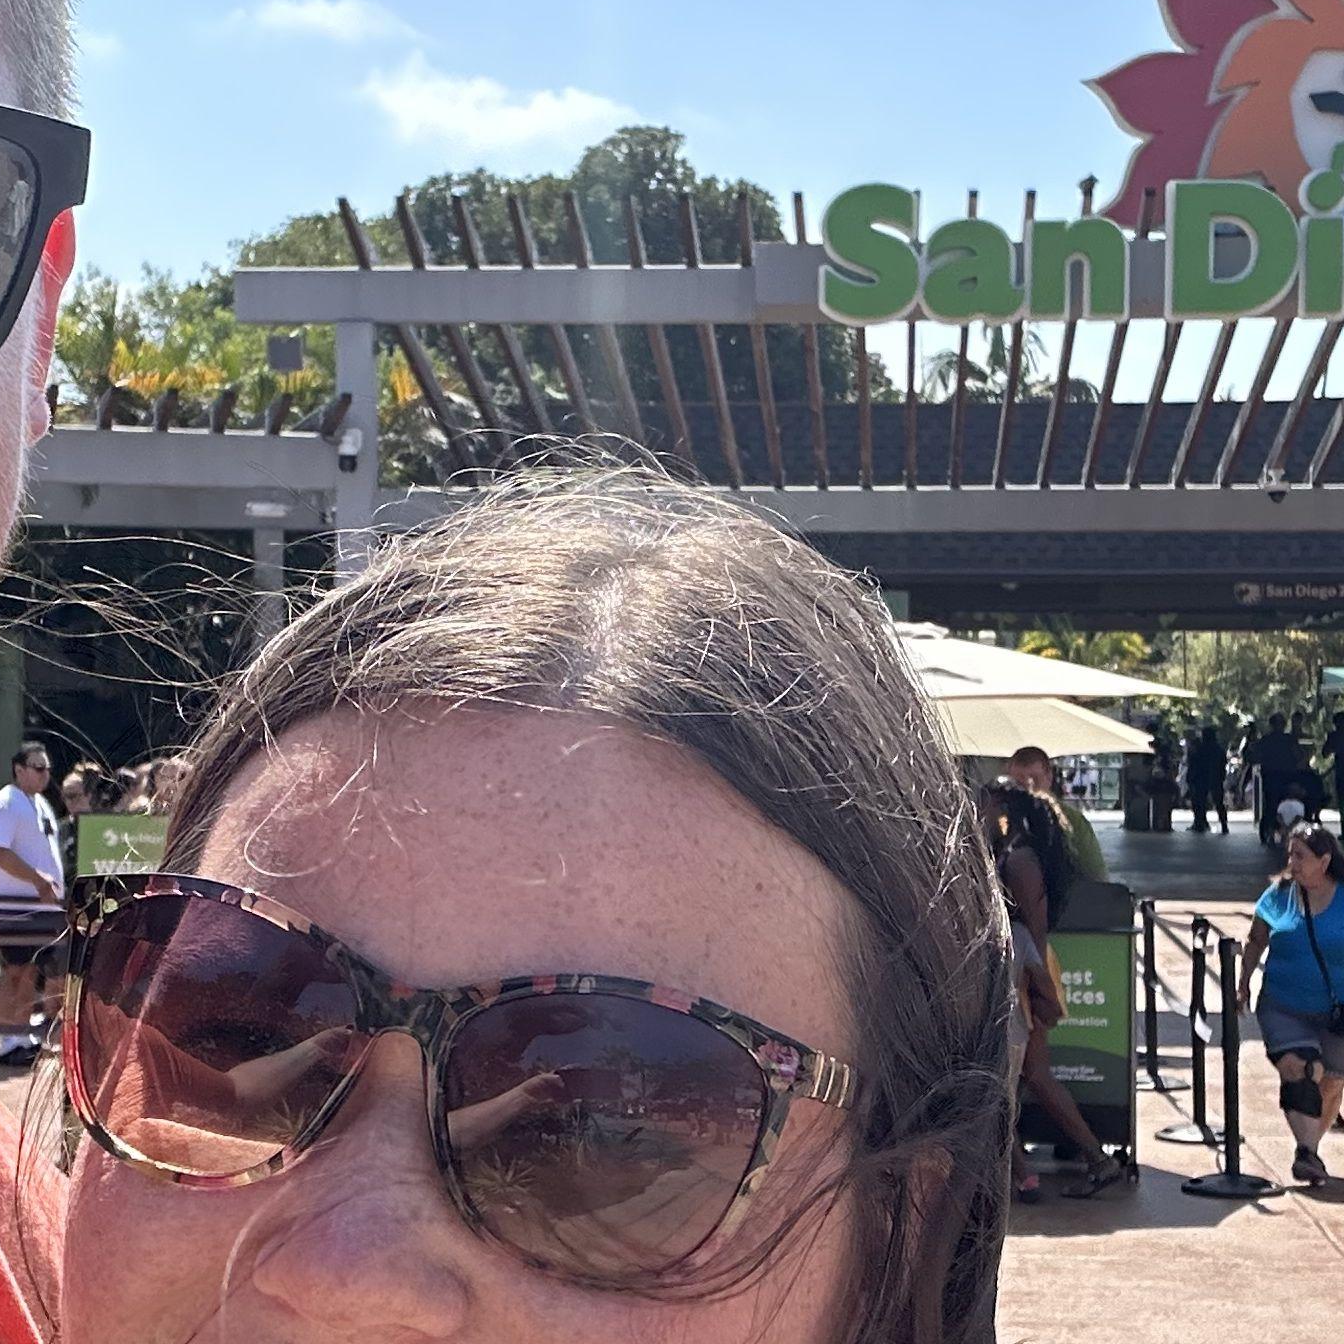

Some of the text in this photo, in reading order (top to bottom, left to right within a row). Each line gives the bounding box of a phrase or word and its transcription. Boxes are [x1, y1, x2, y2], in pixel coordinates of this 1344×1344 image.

[818, 182, 1130, 326] San
[1266, 582, 1293, 598] San
[1295, 582, 1337, 601] Diego
[1060, 969, 1093, 986] est
[1065, 986, 1105, 1005] ices
[1056, 1016, 1108, 1028] ormation
